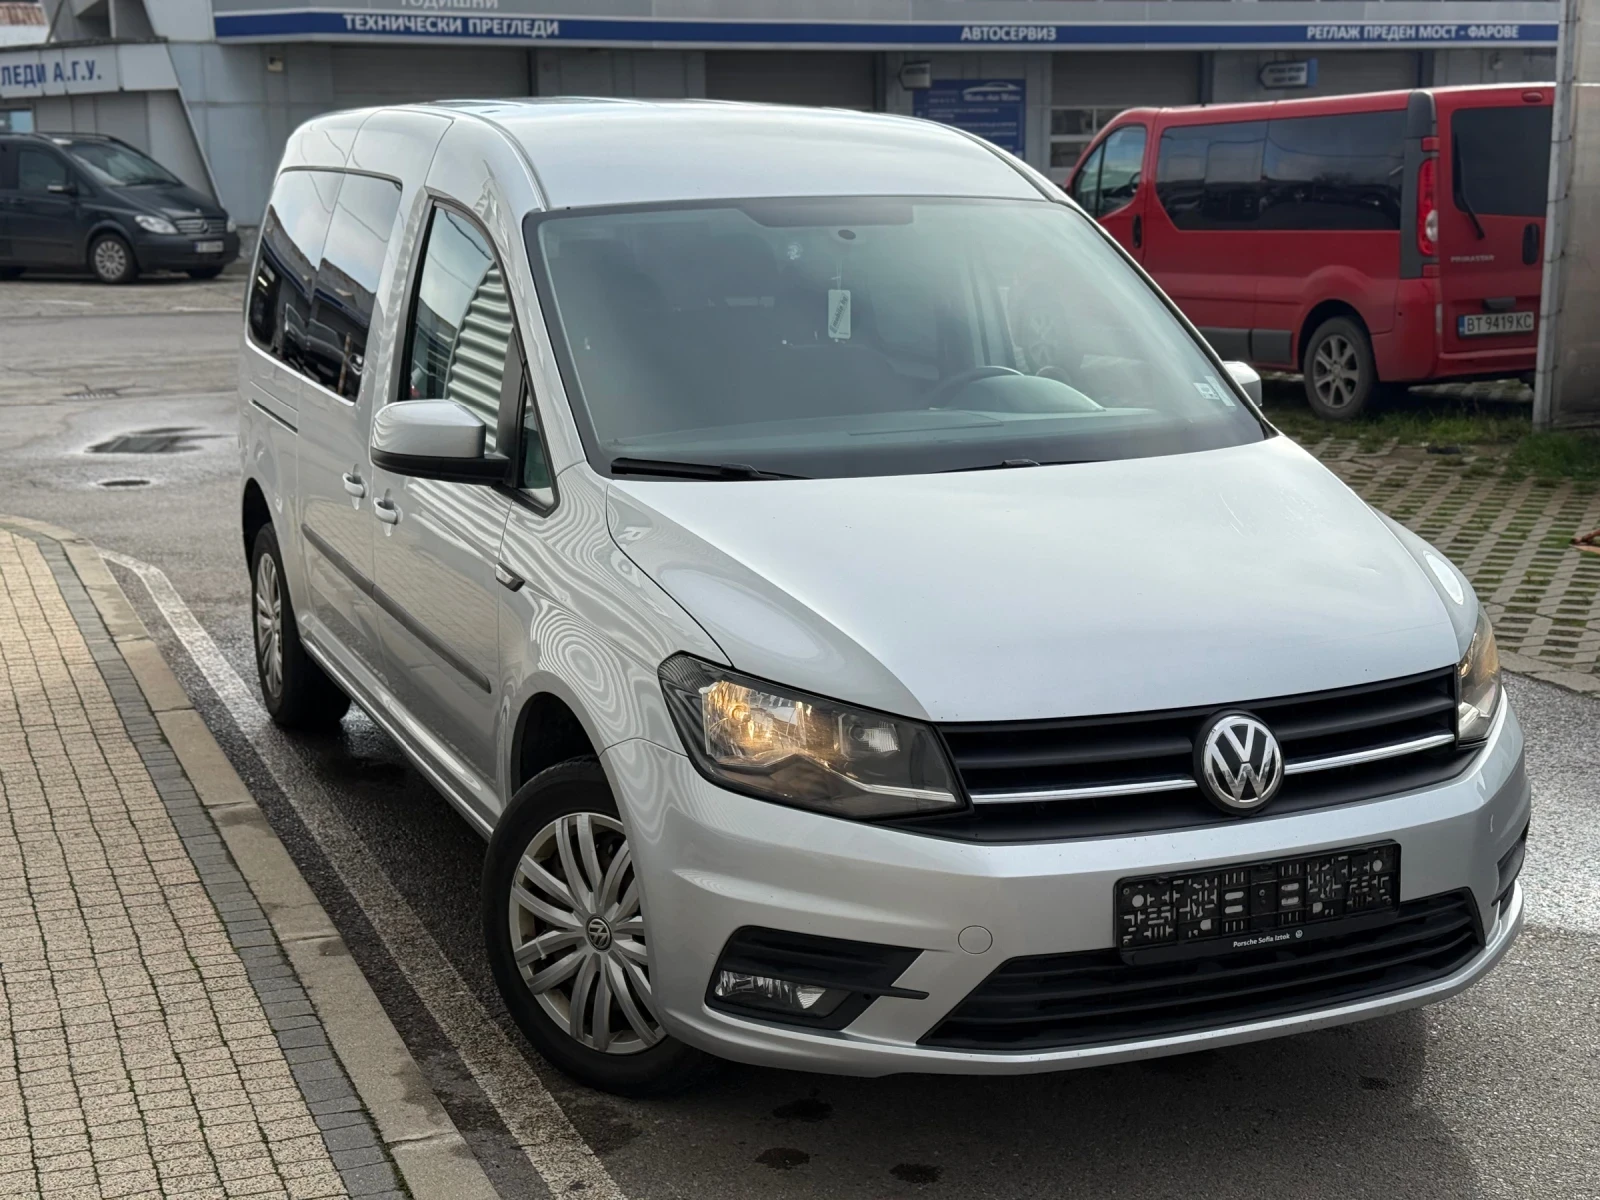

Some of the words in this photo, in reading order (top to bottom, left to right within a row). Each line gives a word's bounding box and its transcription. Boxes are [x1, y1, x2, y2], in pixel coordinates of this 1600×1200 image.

[343, 14, 462, 33] ТЕХНИЧЕСКИ
[468, 18, 560, 38] ПРЕГЛЕДИ
[960, 26, 1057, 41] АВТОСЕРВИЗ
[1306, 25, 1361, 40] РЕГЛАЖ
[1364, 25, 1416, 41] ПРЕДЕН
[1418, 25, 1457, 39] МОСТ
[1467, 25, 1520, 39] ФАРОВЕ
[53, 59, 103, 82] А.Г.У.
[1233, 938, 1257, 948] Porsche
[1258, 935, 1274, 944] Sofia
[1274, 933, 1290, 942] Iztok
